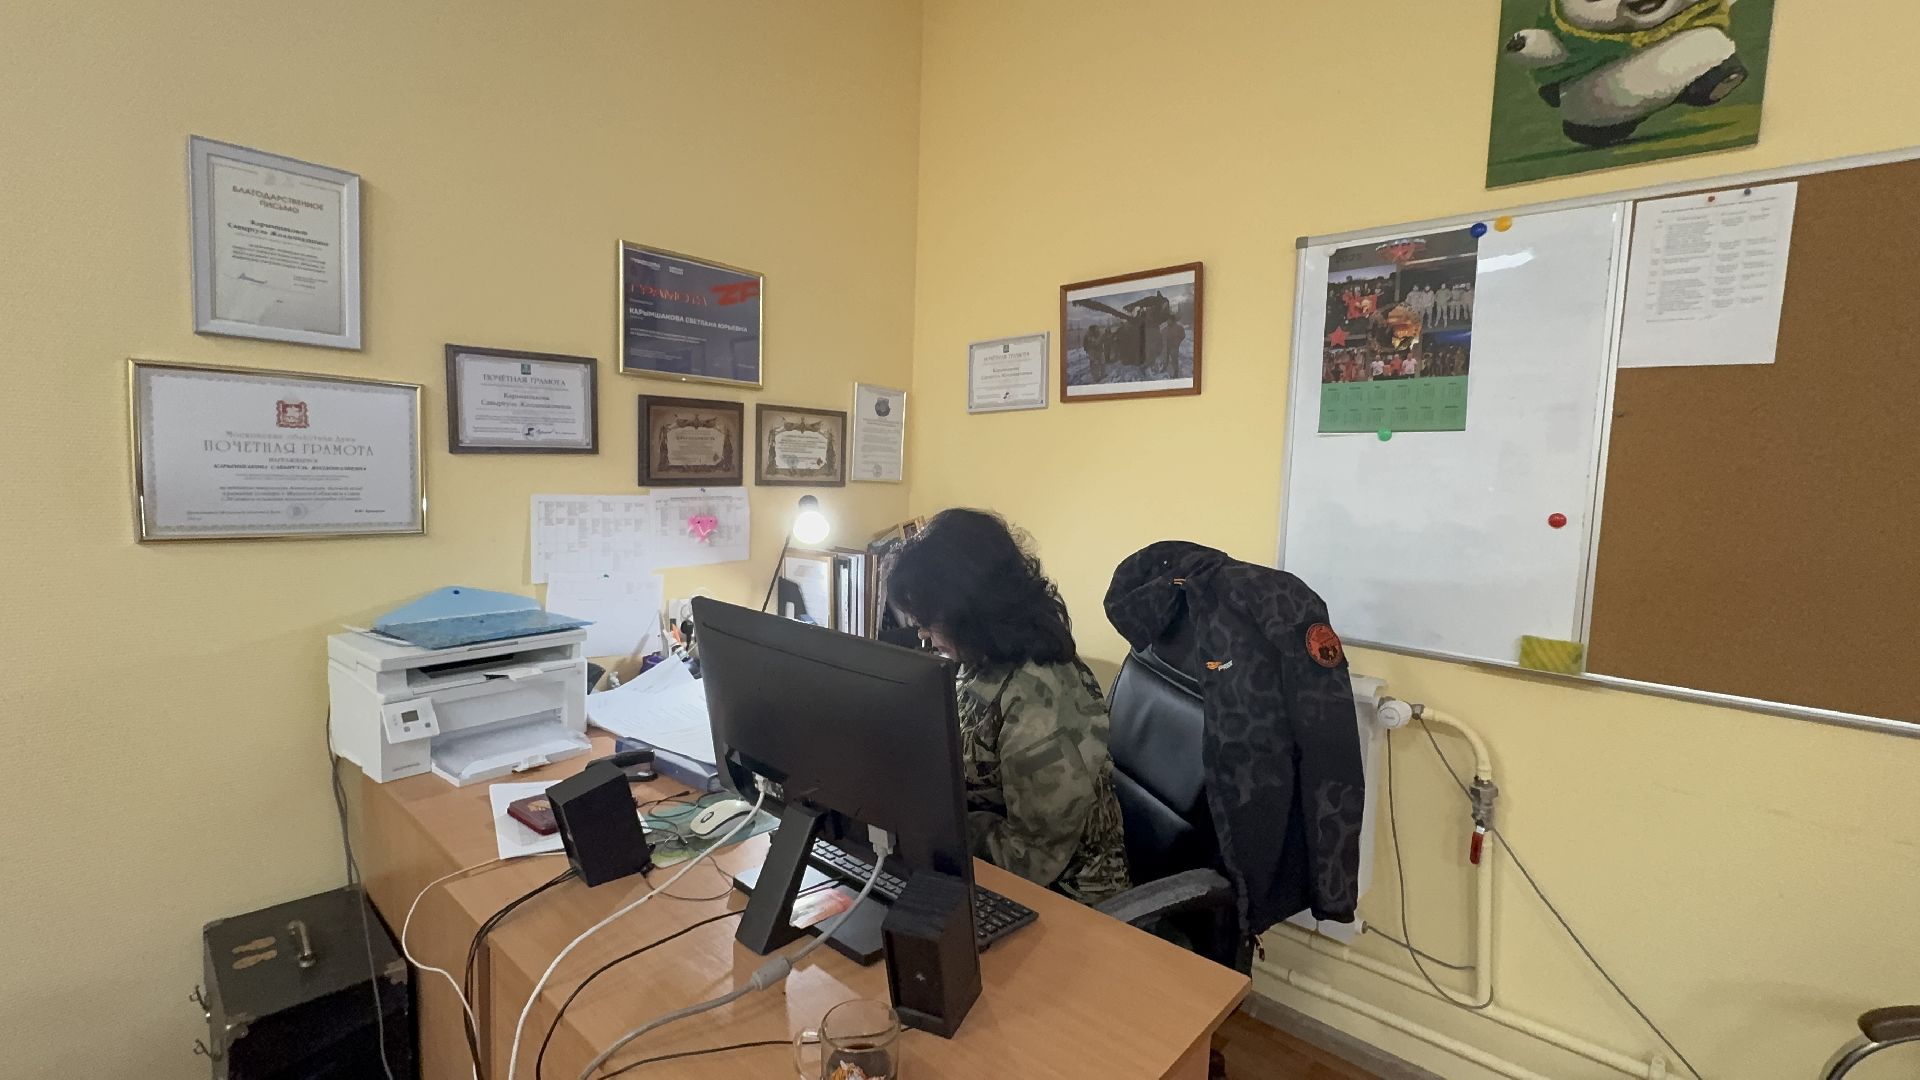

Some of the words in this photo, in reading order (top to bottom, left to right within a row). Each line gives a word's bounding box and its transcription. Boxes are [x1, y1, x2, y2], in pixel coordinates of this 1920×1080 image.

[232, 185, 324, 211] БЛАГОДАРСТВЕННОЕ
[259, 200, 300, 214] ПИСЬМО
[629, 307, 684, 323] КАРЫМШАКОВА
[685, 317, 717, 329] СВЕТЛАНА
[718, 323, 748, 333] ЮРЬЕВНА
[530, 377, 566, 386] ГРАМОТА
[302, 444, 374, 457] ГРАМОТА
